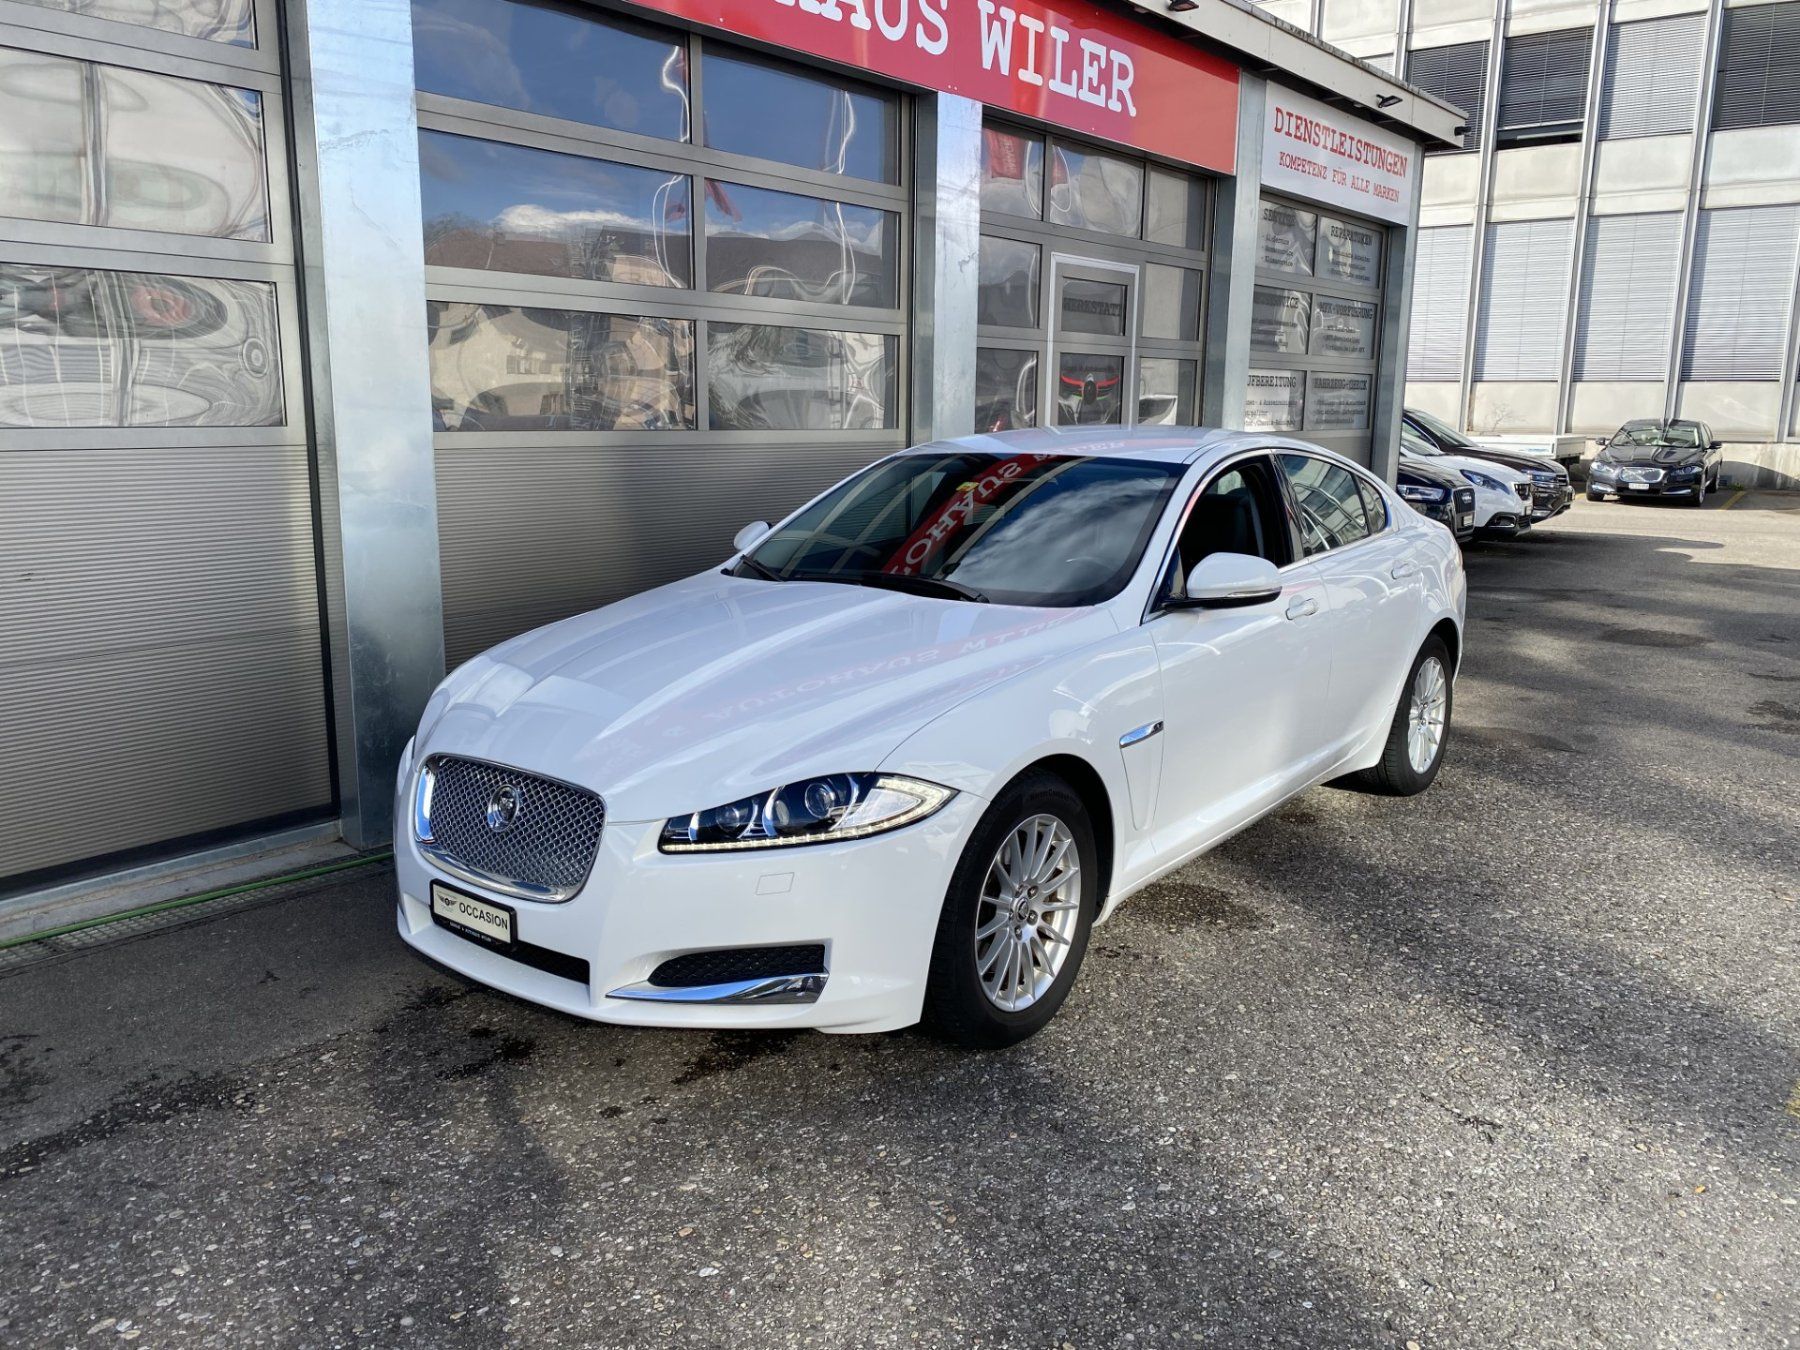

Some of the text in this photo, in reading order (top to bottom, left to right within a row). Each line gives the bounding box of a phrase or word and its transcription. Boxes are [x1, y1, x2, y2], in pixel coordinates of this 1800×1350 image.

[775, 0, 1137, 117] US WILER
[1274, 106, 1408, 178] DIENSTLEISTUNGEN
[1279, 151, 1400, 203] KOMPETENZ FÜR ALLE MARKEN
[459, 902, 508, 930] OCCASION
